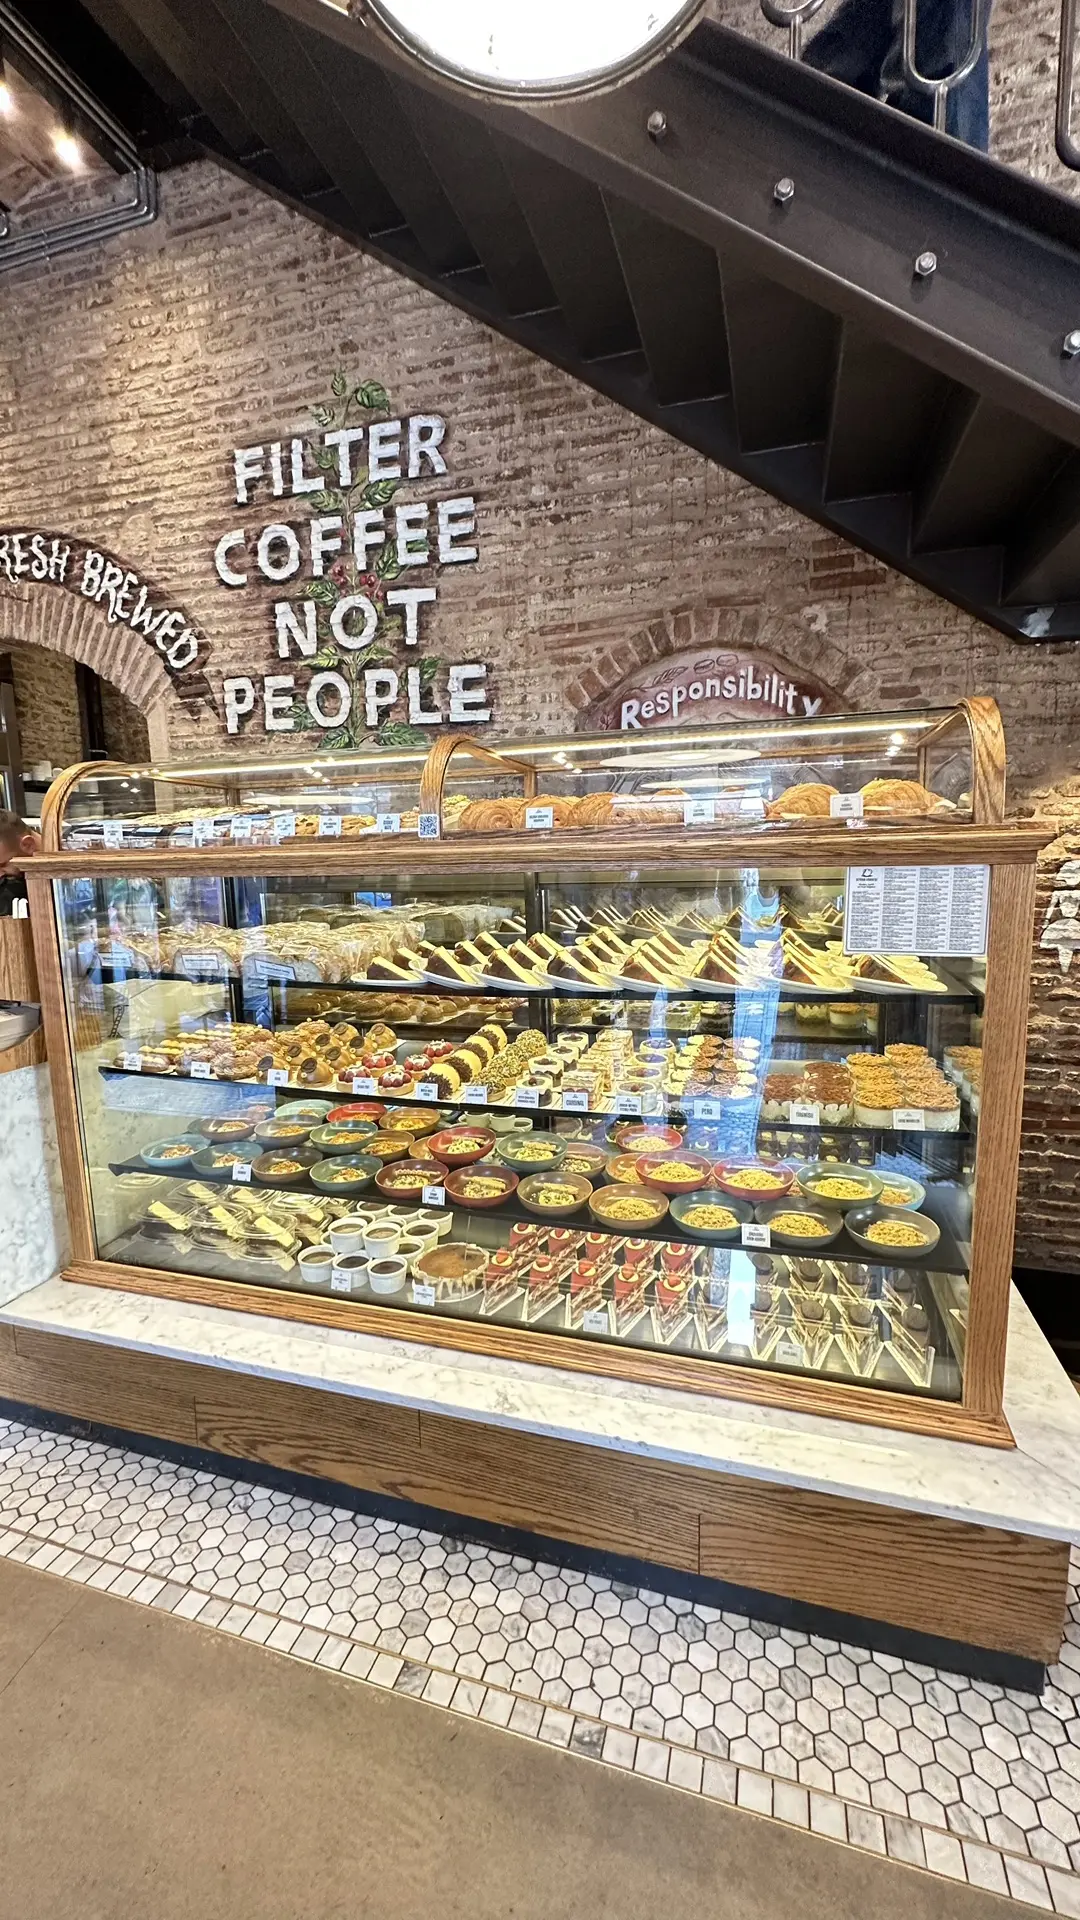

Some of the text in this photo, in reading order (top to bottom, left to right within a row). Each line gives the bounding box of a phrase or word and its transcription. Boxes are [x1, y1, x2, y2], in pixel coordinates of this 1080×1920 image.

[233, 414, 448, 504] FILTER
[214, 497, 479, 587] COFFEE
[0, 533, 198, 669] RESH BREWED
[275, 587, 437, 659] NOT
[223, 663, 493, 734] PEOPLE
[621, 665, 822, 730] Responsibility
